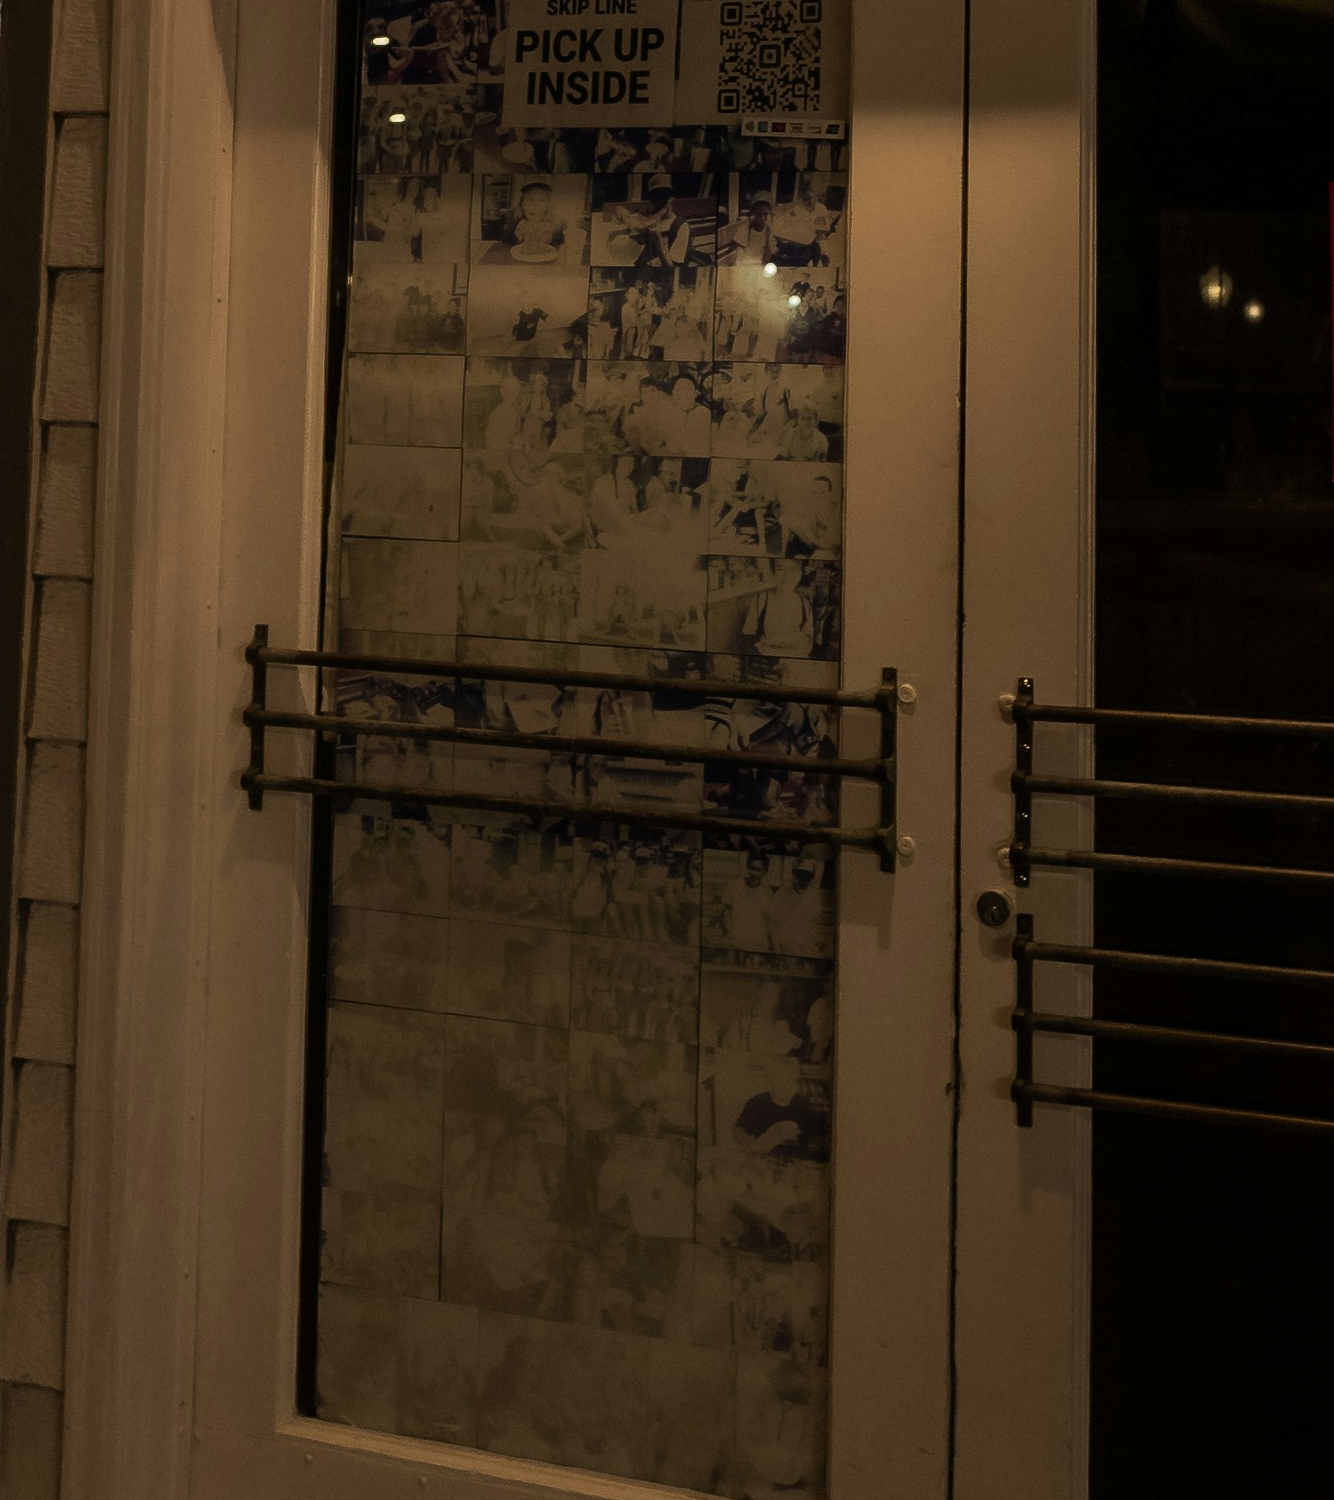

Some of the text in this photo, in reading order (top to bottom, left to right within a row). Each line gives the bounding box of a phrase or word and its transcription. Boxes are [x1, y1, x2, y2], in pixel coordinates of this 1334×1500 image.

[514, 27, 665, 64] PICK UP
[527, 70, 651, 105] INSIDE
